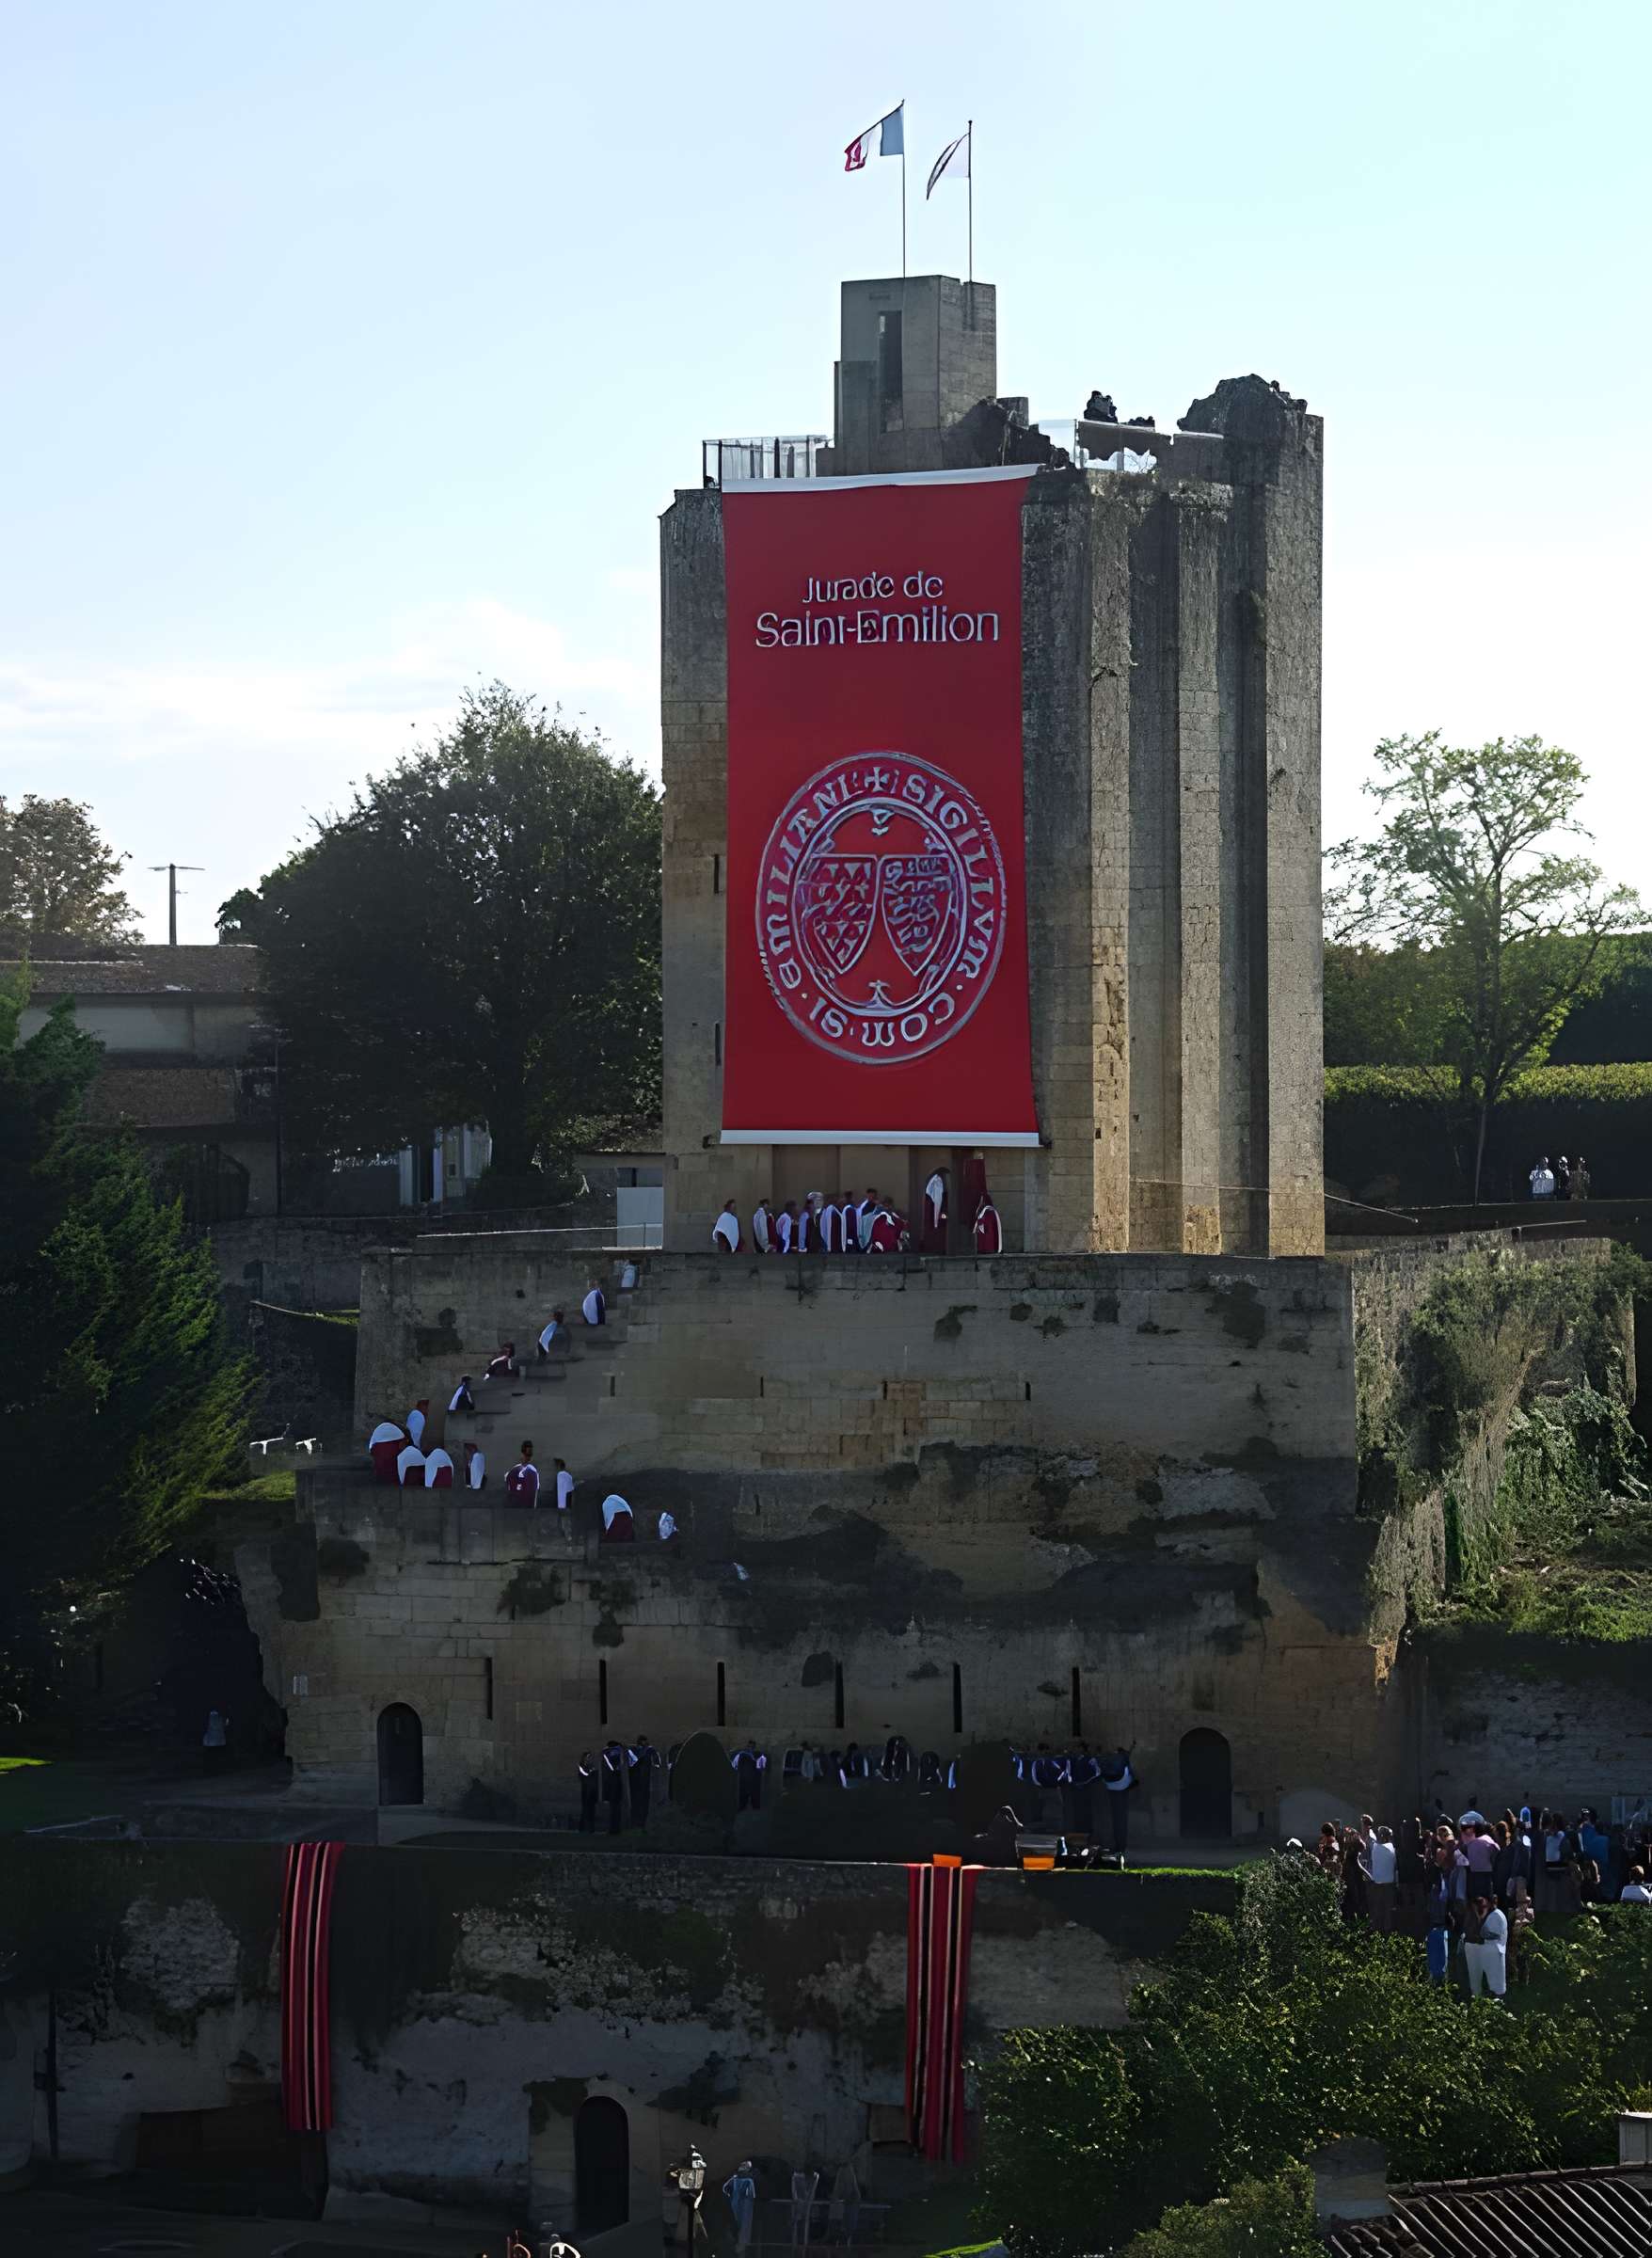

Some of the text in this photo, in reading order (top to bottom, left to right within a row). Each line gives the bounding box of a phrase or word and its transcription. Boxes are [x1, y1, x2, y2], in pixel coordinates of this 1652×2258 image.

[802, 571, 943, 603] Jurade de
[755, 605, 999, 647] Saint-Emilion
